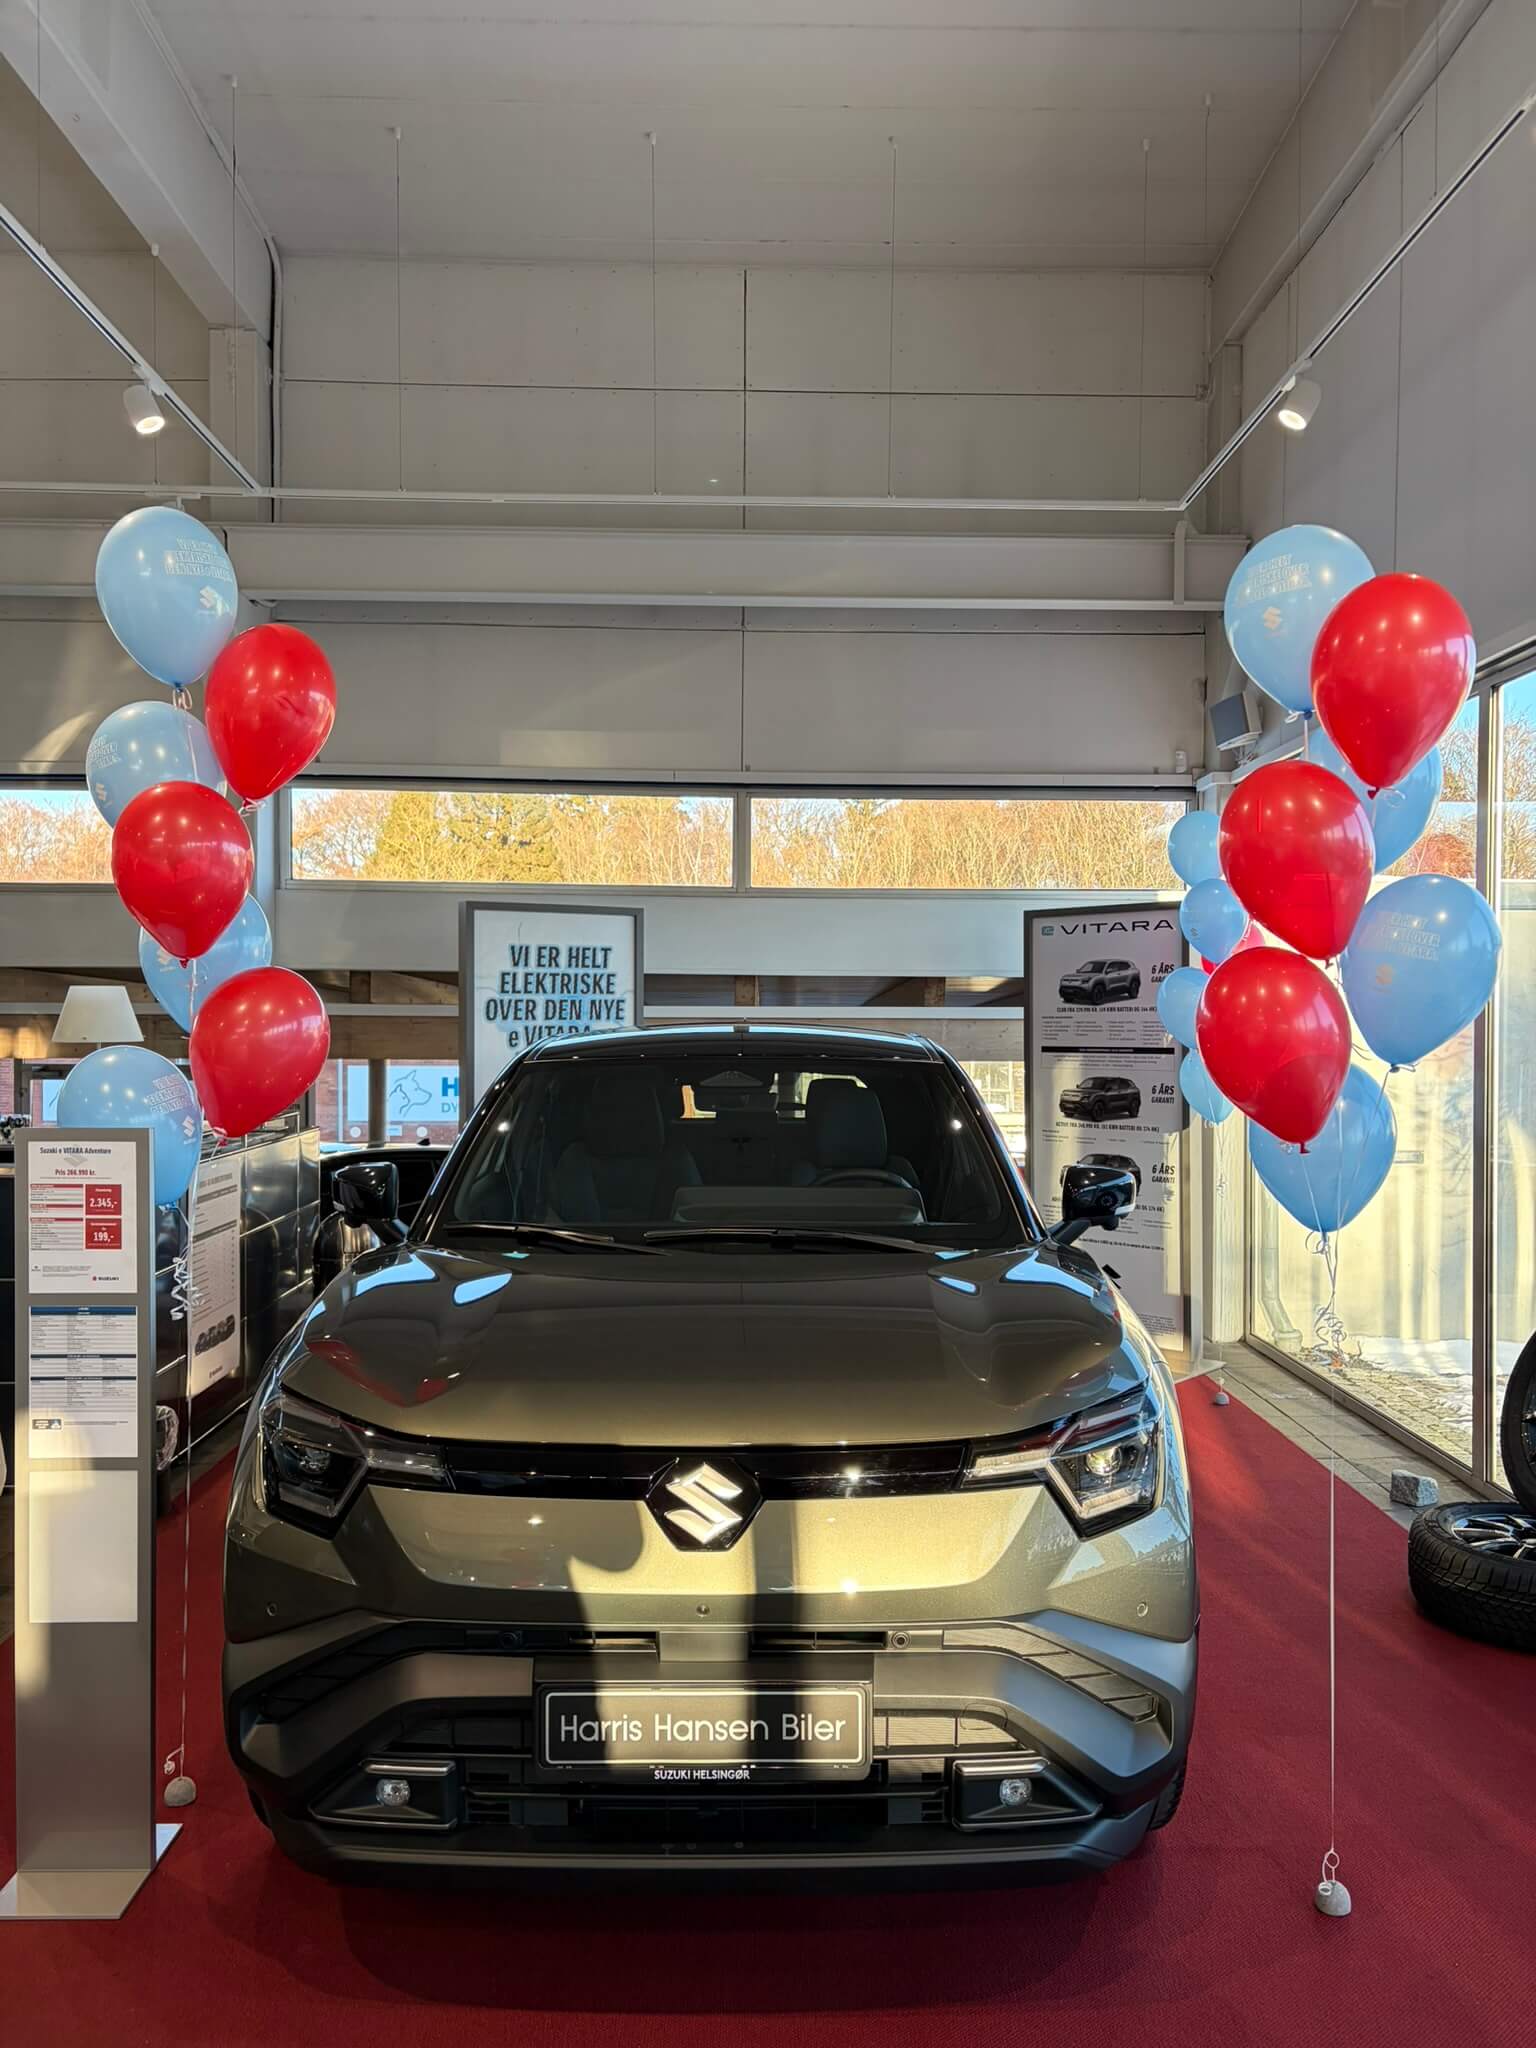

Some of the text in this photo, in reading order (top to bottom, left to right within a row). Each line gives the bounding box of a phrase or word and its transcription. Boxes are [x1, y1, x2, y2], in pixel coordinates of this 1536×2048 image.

[1060, 919, 1174, 935] VITARA
[510, 945, 612, 969] VI ER HELT
[1151, 965, 1157, 974] 6
[500, 972, 616, 995] ELEKTRISKE
[486, 999, 625, 1021] OVER DEN NYE
[508, 1030, 518, 1047] e
[1151, 1082, 1175, 1095] 6 ÅRS
[1151, 1096, 1175, 1104] GARANTI
[1152, 1163, 1175, 1174] 6 ÅRS
[1151, 1176, 1175, 1184] GARANTI
[93, 1232, 114, 1242] 199,-
[560, 1713, 846, 1742] Harris Hansen Biler
[654, 1769, 750, 1780] SUZUKI HELSINGØR
